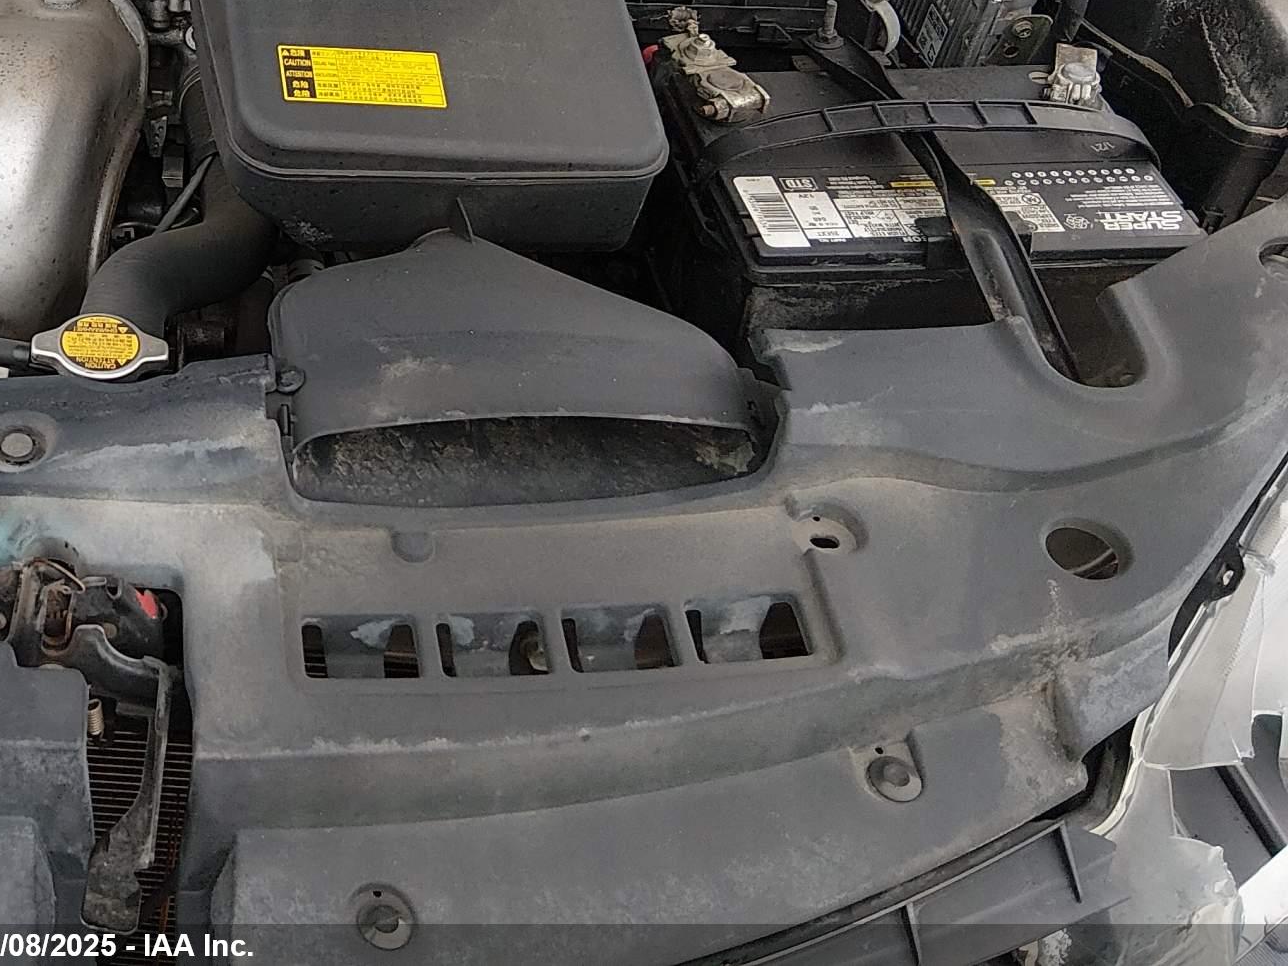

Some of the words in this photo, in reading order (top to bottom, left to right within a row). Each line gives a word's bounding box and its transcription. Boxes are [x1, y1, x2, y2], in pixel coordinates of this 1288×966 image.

[284, 58, 312, 66] CAUTION
[785, 179, 813, 188] STD
[1099, 210, 1183, 222] START
[1102, 220, 1180, 231] SUPER
